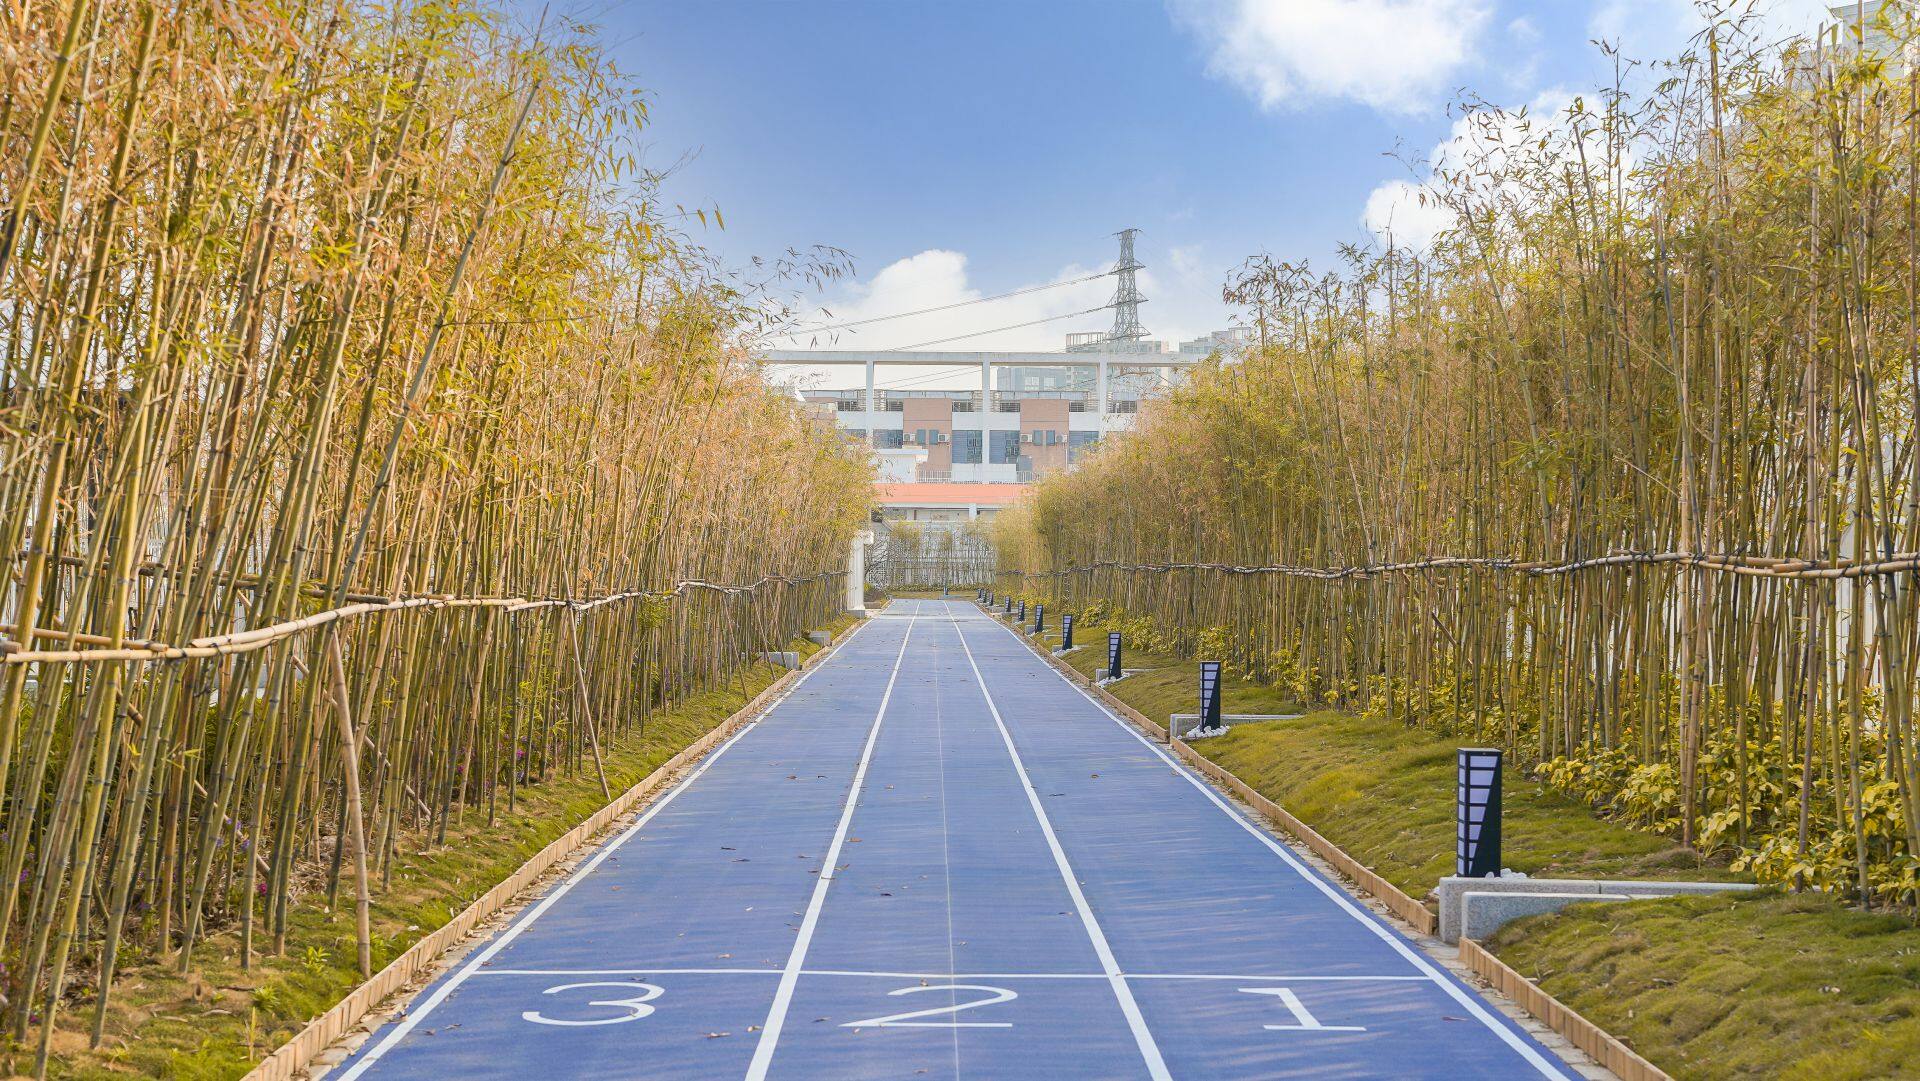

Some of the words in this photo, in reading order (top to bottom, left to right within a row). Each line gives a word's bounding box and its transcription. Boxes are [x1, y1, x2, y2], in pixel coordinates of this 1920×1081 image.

[522, 982, 664, 1026] 3
[839, 985, 1018, 1028] 2
[1238, 987, 1366, 1031] 1
